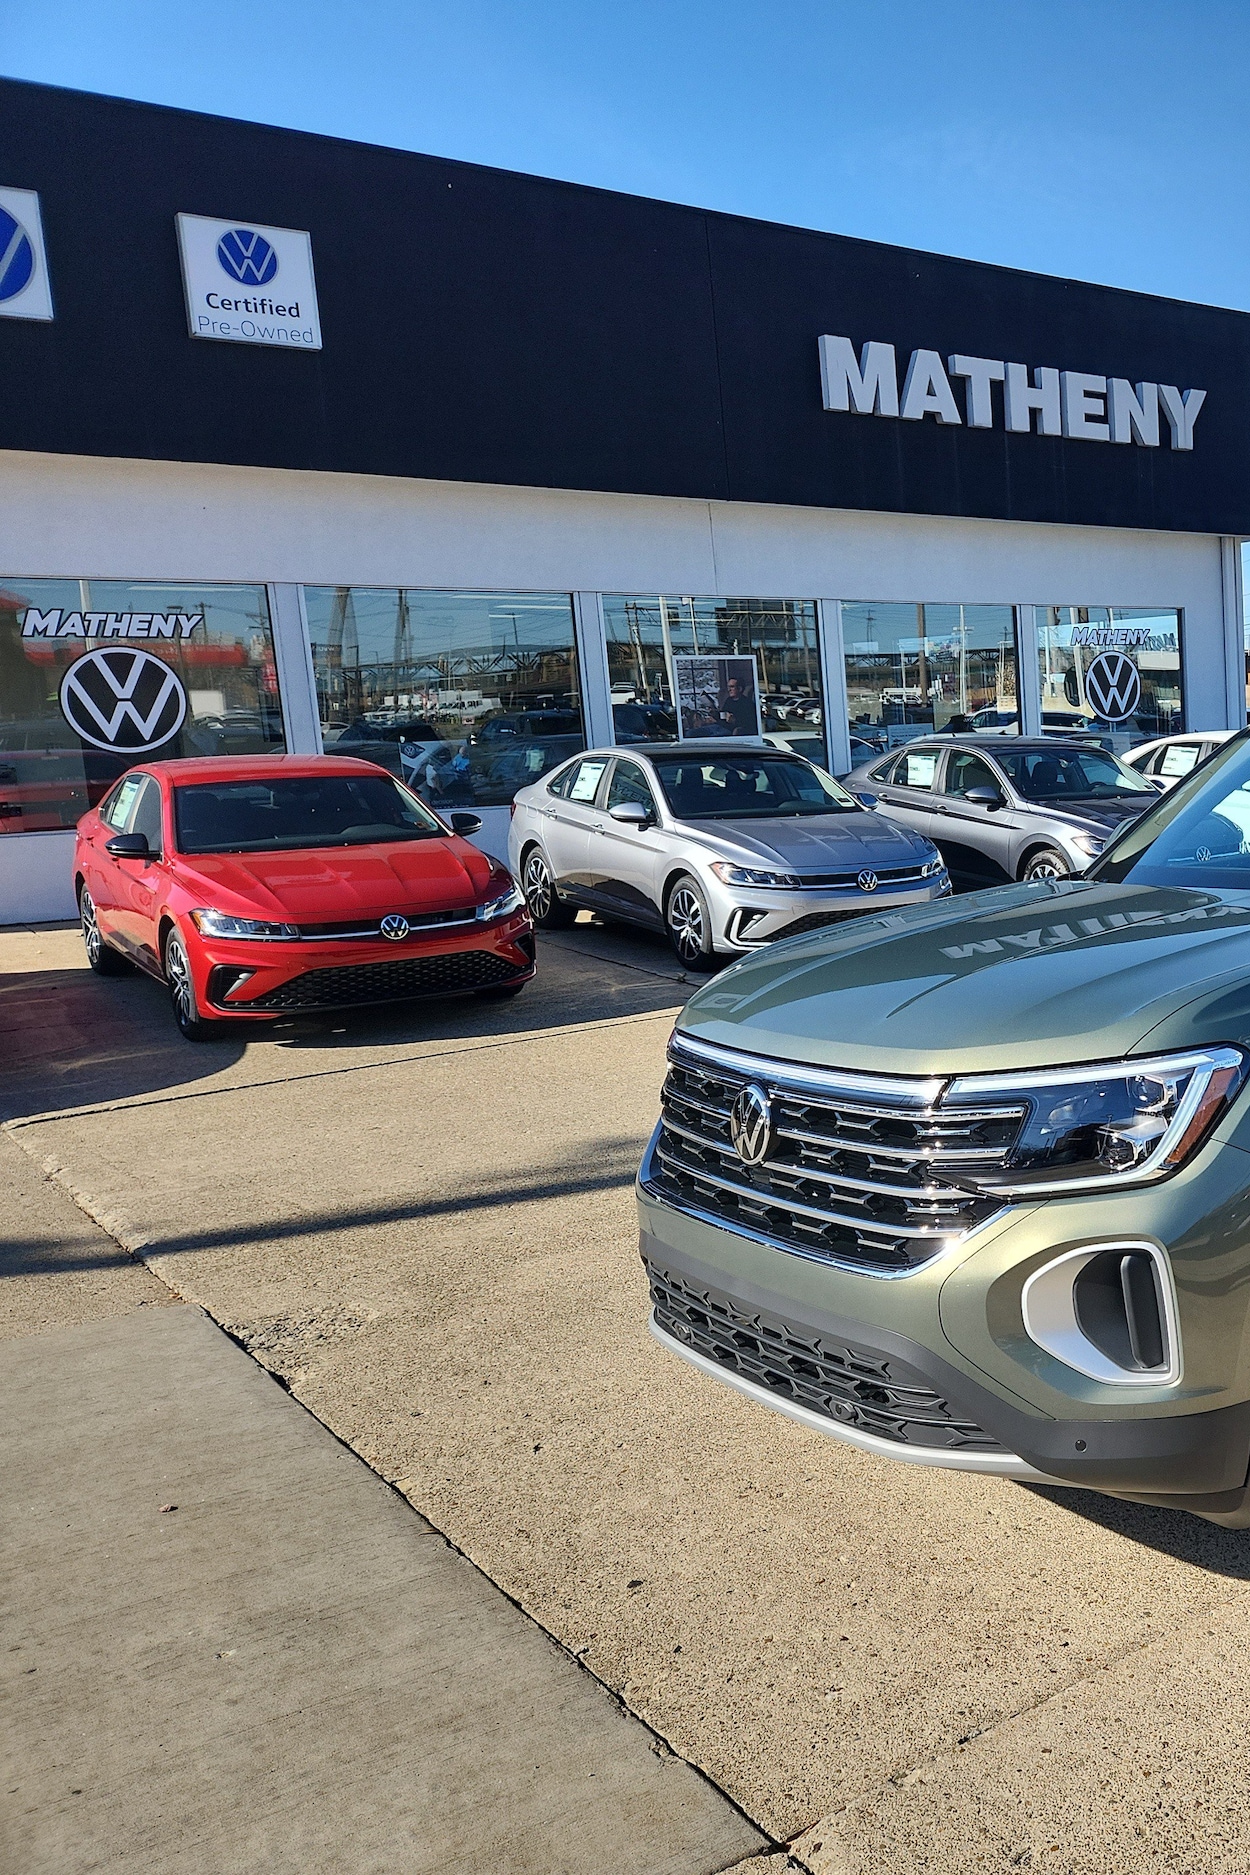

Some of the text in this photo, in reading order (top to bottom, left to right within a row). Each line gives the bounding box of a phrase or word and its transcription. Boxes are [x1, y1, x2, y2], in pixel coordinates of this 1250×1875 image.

[205, 292, 301, 318] Certified
[197, 315, 314, 344] Pre-Owned
[818, 334, 1208, 451] MATHENY
[22, 608, 204, 638] MATHENY
[1070, 627, 1150, 646] MATHENY
